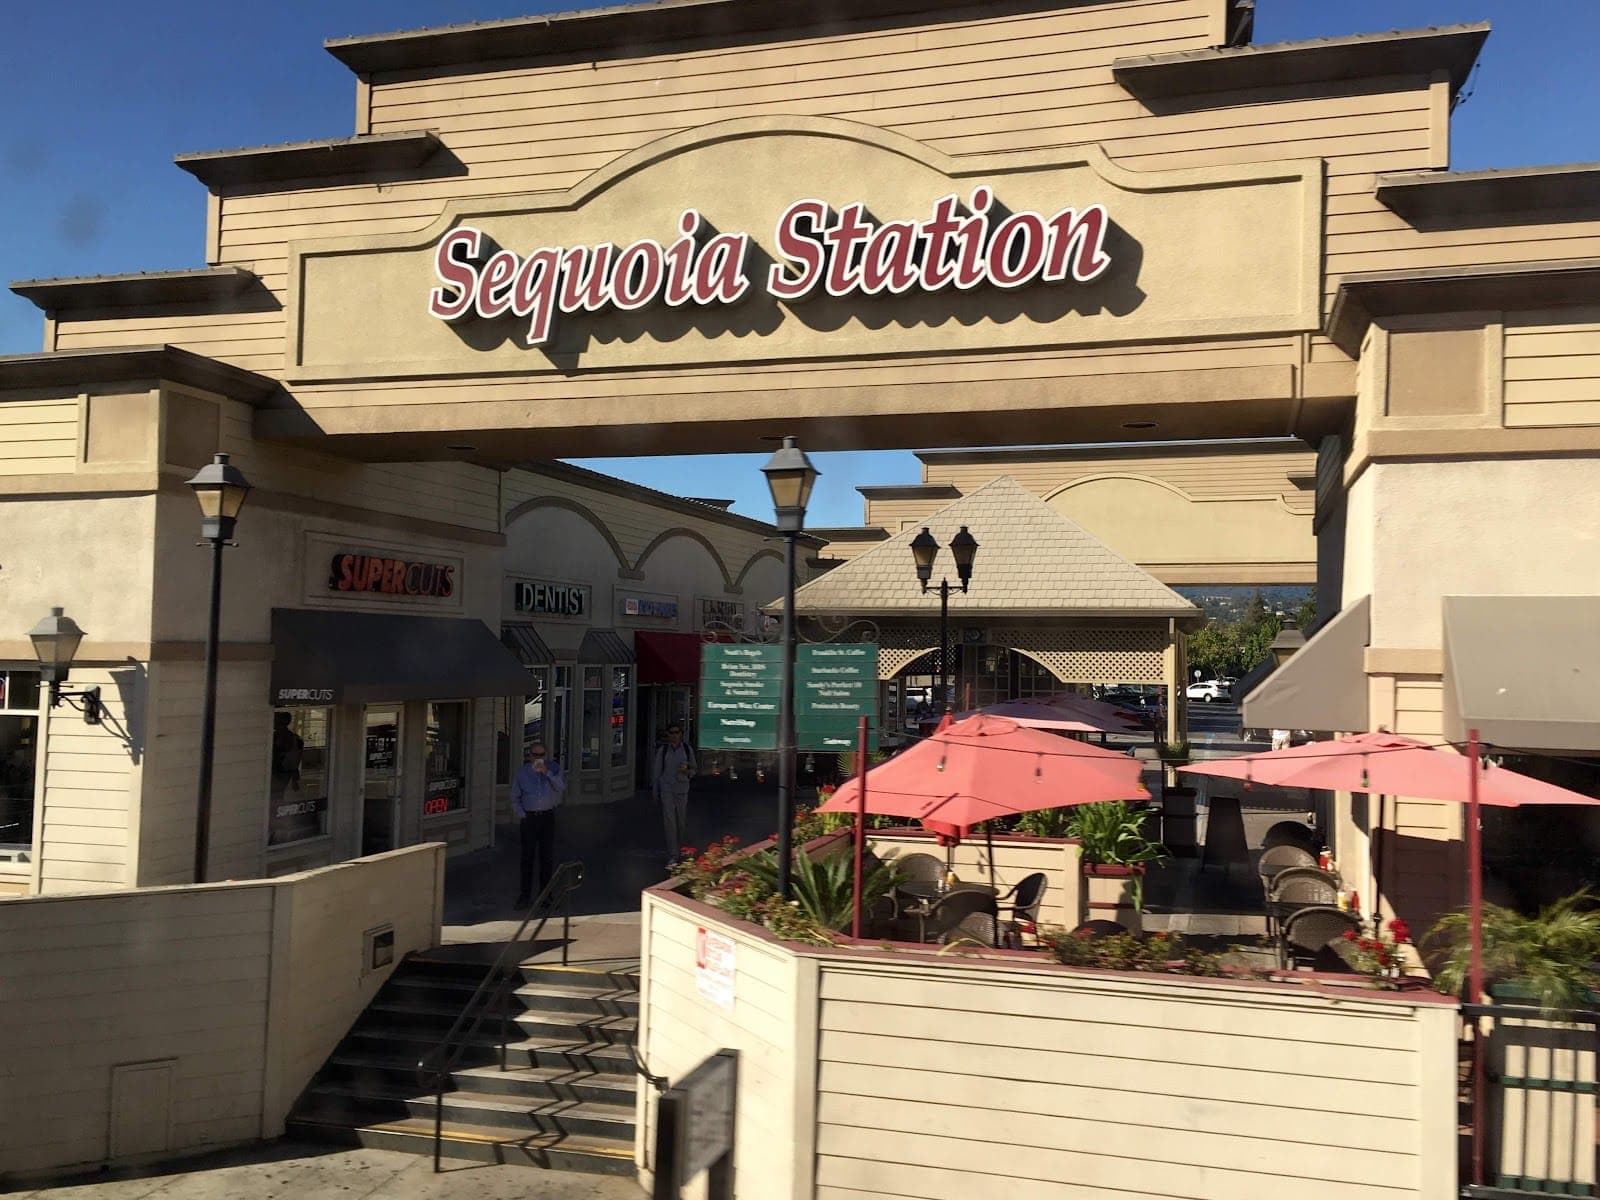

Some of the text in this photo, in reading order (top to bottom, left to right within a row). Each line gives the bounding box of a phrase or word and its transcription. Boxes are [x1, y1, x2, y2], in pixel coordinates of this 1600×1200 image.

[429, 185, 1113, 346] Sequoia Station
[335, 553, 456, 598] SUPERCUTS
[520, 582, 587, 615] DENTIST
[277, 687, 335, 701] SUPERCUTS
[424, 797, 448, 815] OPEN
